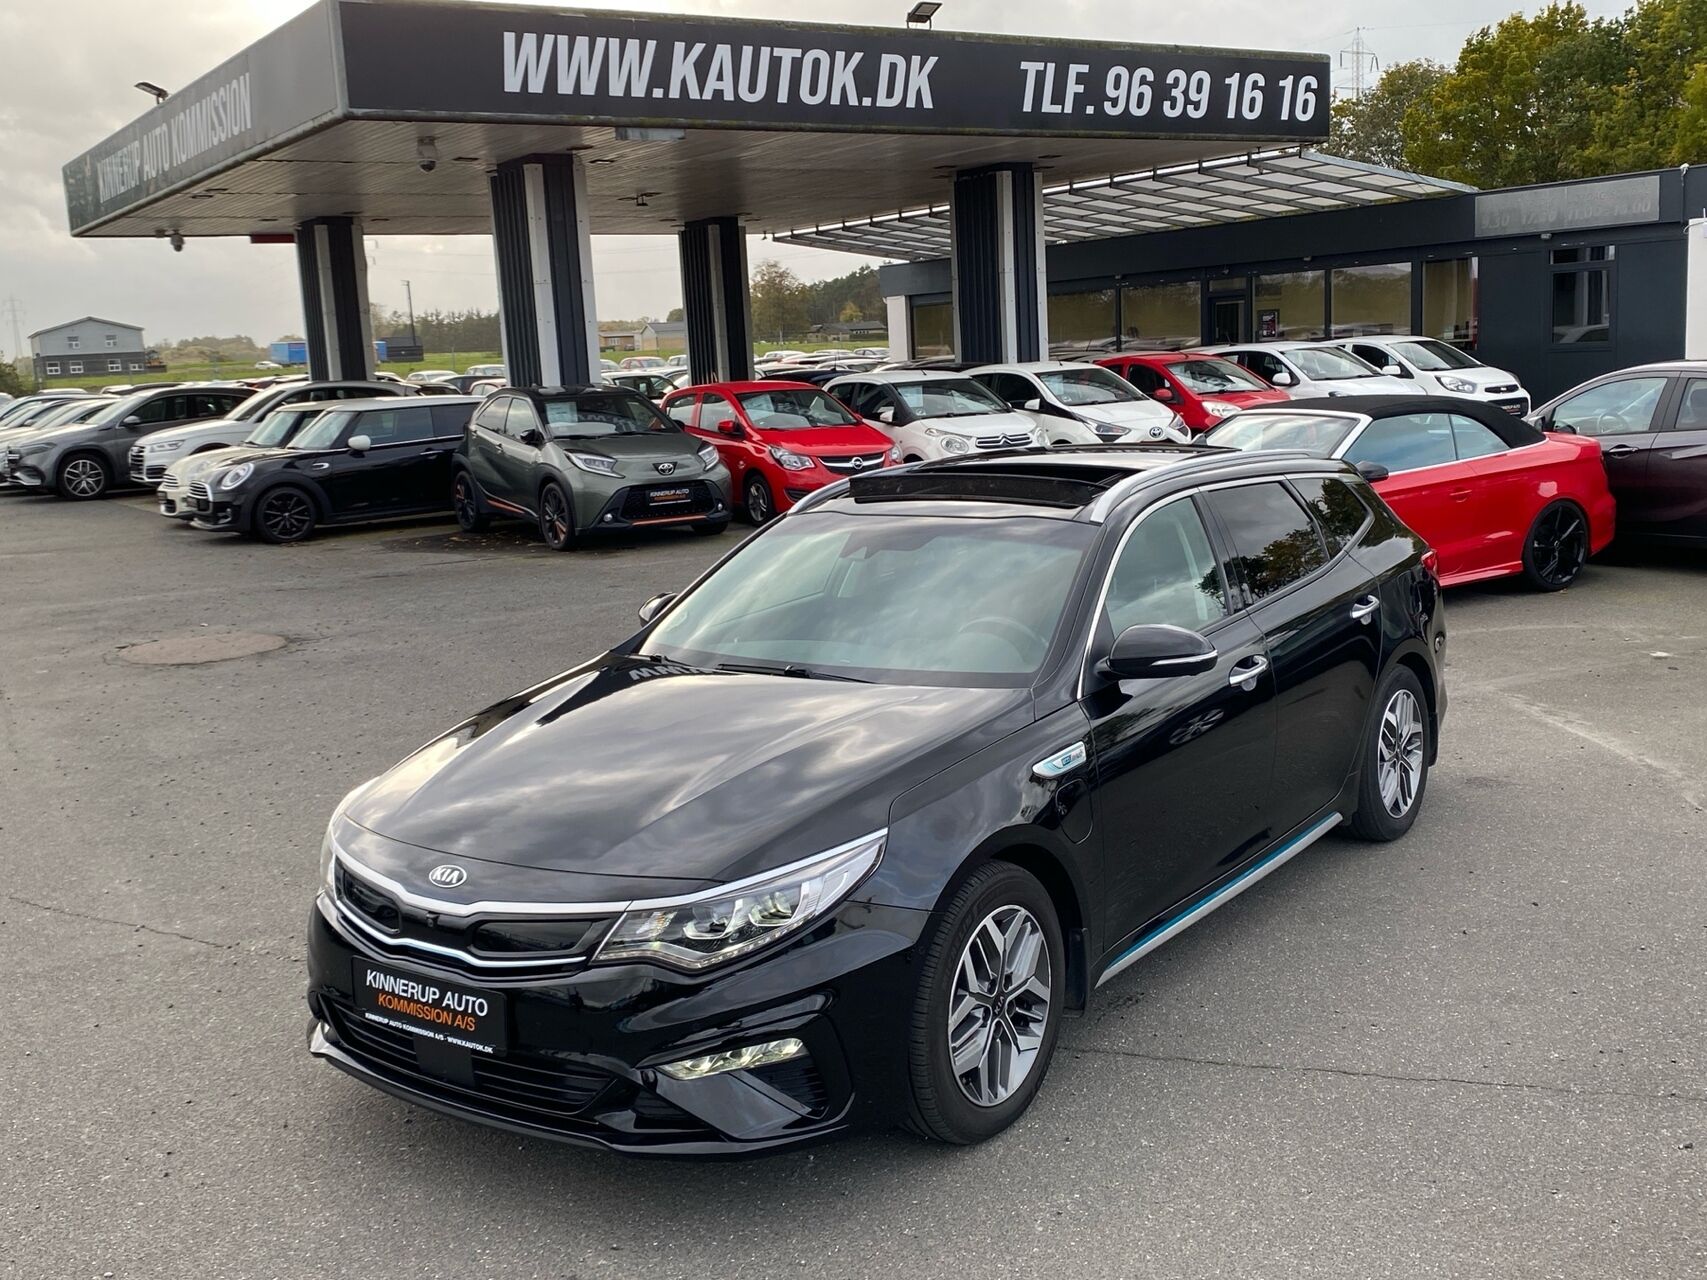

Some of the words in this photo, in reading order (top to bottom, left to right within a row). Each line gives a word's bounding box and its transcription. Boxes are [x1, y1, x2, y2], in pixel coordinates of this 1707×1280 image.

[503, 31, 939, 109] WWW.KAUTOK.DK
[1020, 61, 1095, 114] TLF.
[1103, 65, 1155, 117] 96
[1163, 69, 1211, 119] 39
[1225, 72, 1266, 121] 16
[1279, 75, 1319, 122] 16
[97, 140, 140, 203] KINNERUP
[143, 122, 170, 181] AUTO
[171, 72, 252, 167] KOMMISSION
[432, 867, 460, 883] KIA
[366, 969, 440, 1004] KINNERUP
[442, 991, 488, 1017] AUTO
[378, 993, 453, 1026] KOMMISSION
[454, 1013, 476, 1032] A/S
